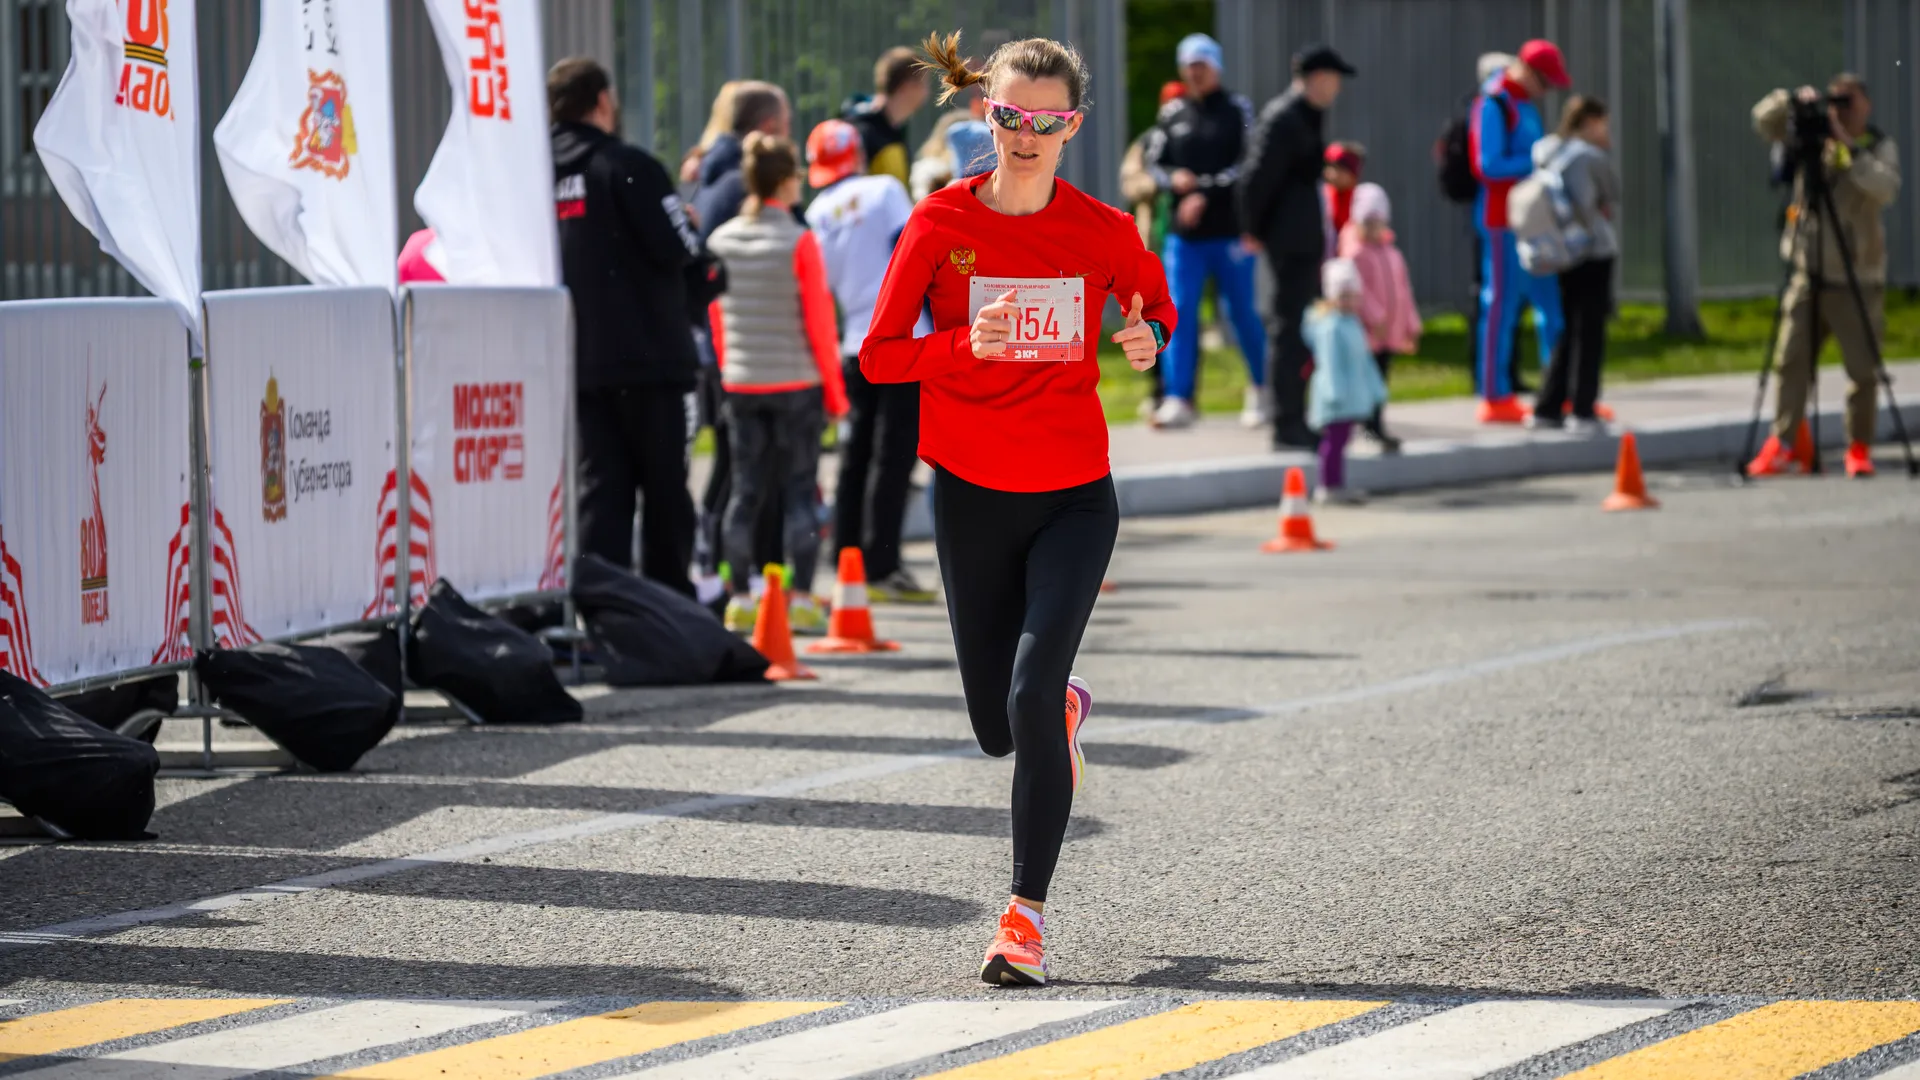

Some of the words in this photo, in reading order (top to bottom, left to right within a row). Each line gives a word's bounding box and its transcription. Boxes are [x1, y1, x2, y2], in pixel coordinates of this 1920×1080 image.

[288, 406, 331, 443] Команда
[453, 381, 524, 430] МОСОБЛ
[289, 457, 352, 504] Губернатора
[80, 516, 97, 579] 80
